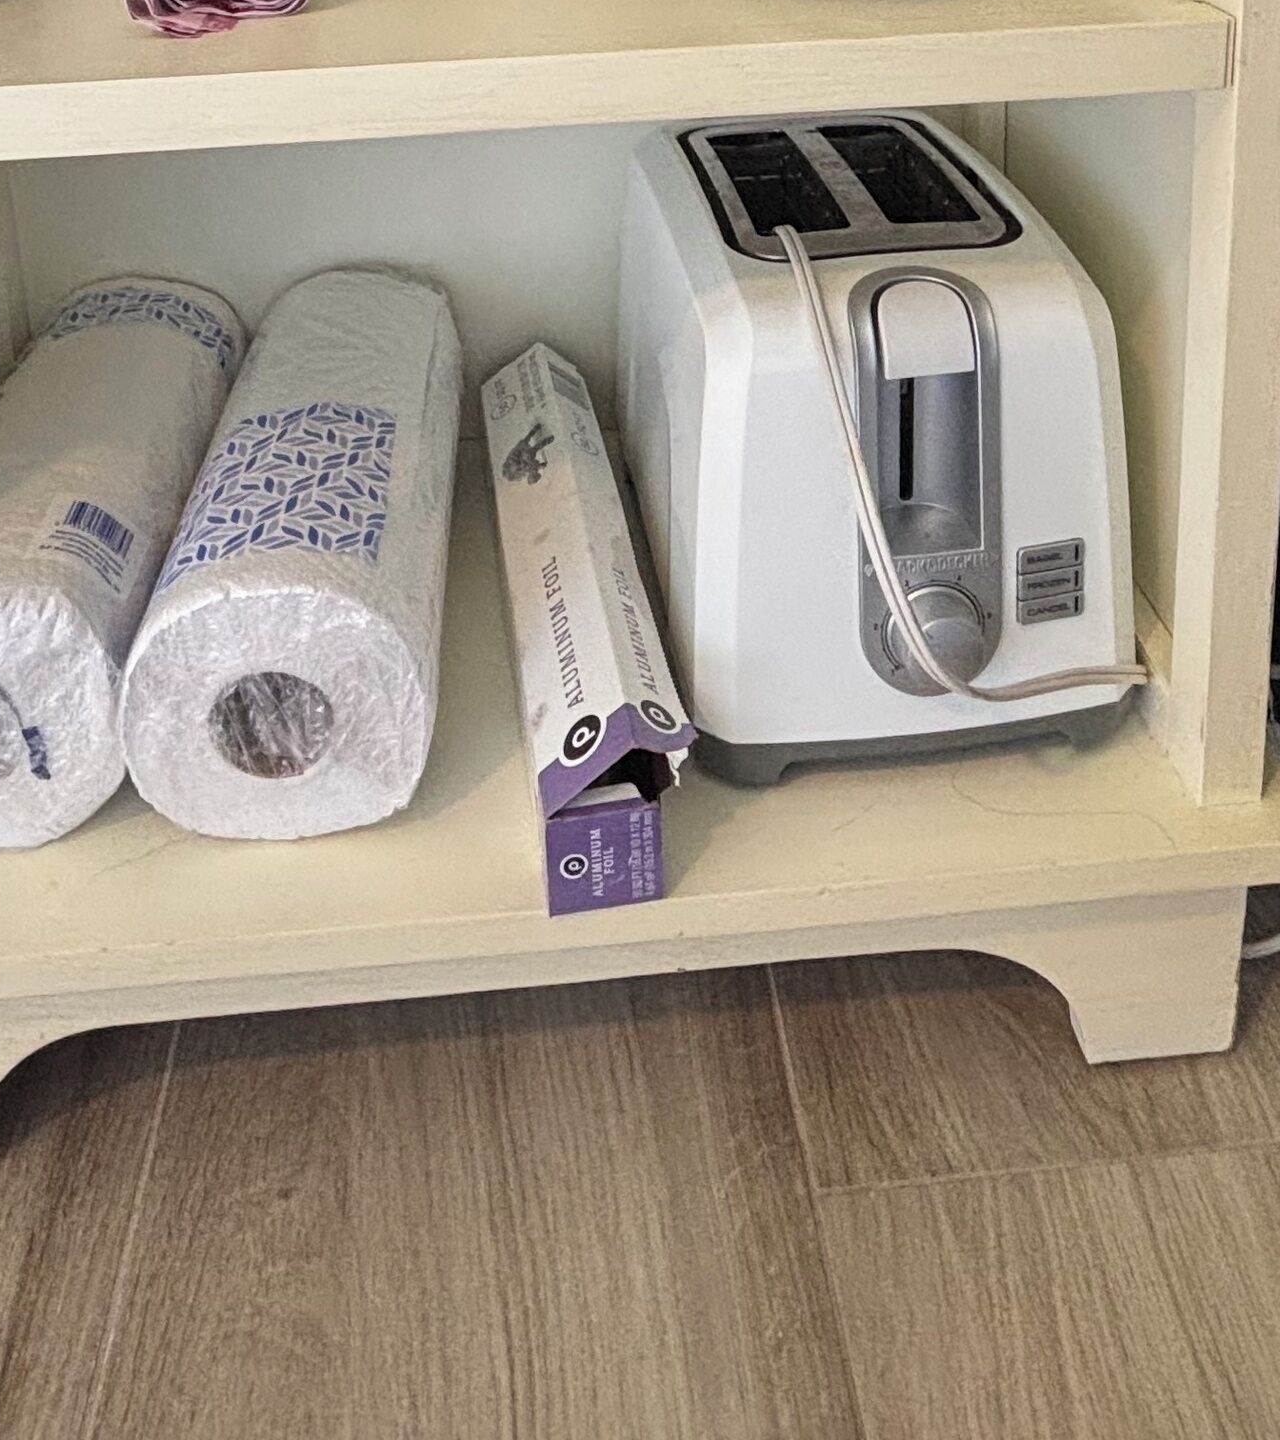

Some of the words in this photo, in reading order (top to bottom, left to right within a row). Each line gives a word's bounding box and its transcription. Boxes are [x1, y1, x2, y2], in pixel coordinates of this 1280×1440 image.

[541, 556, 562, 600] FOIL
[612, 568, 633, 602] FOIL
[549, 597, 584, 709] ALUMINUM
[621, 601, 659, 696] ALUMINUM
[589, 827, 604, 897] ALUMINUM
[603, 846, 616, 875] FOIL
